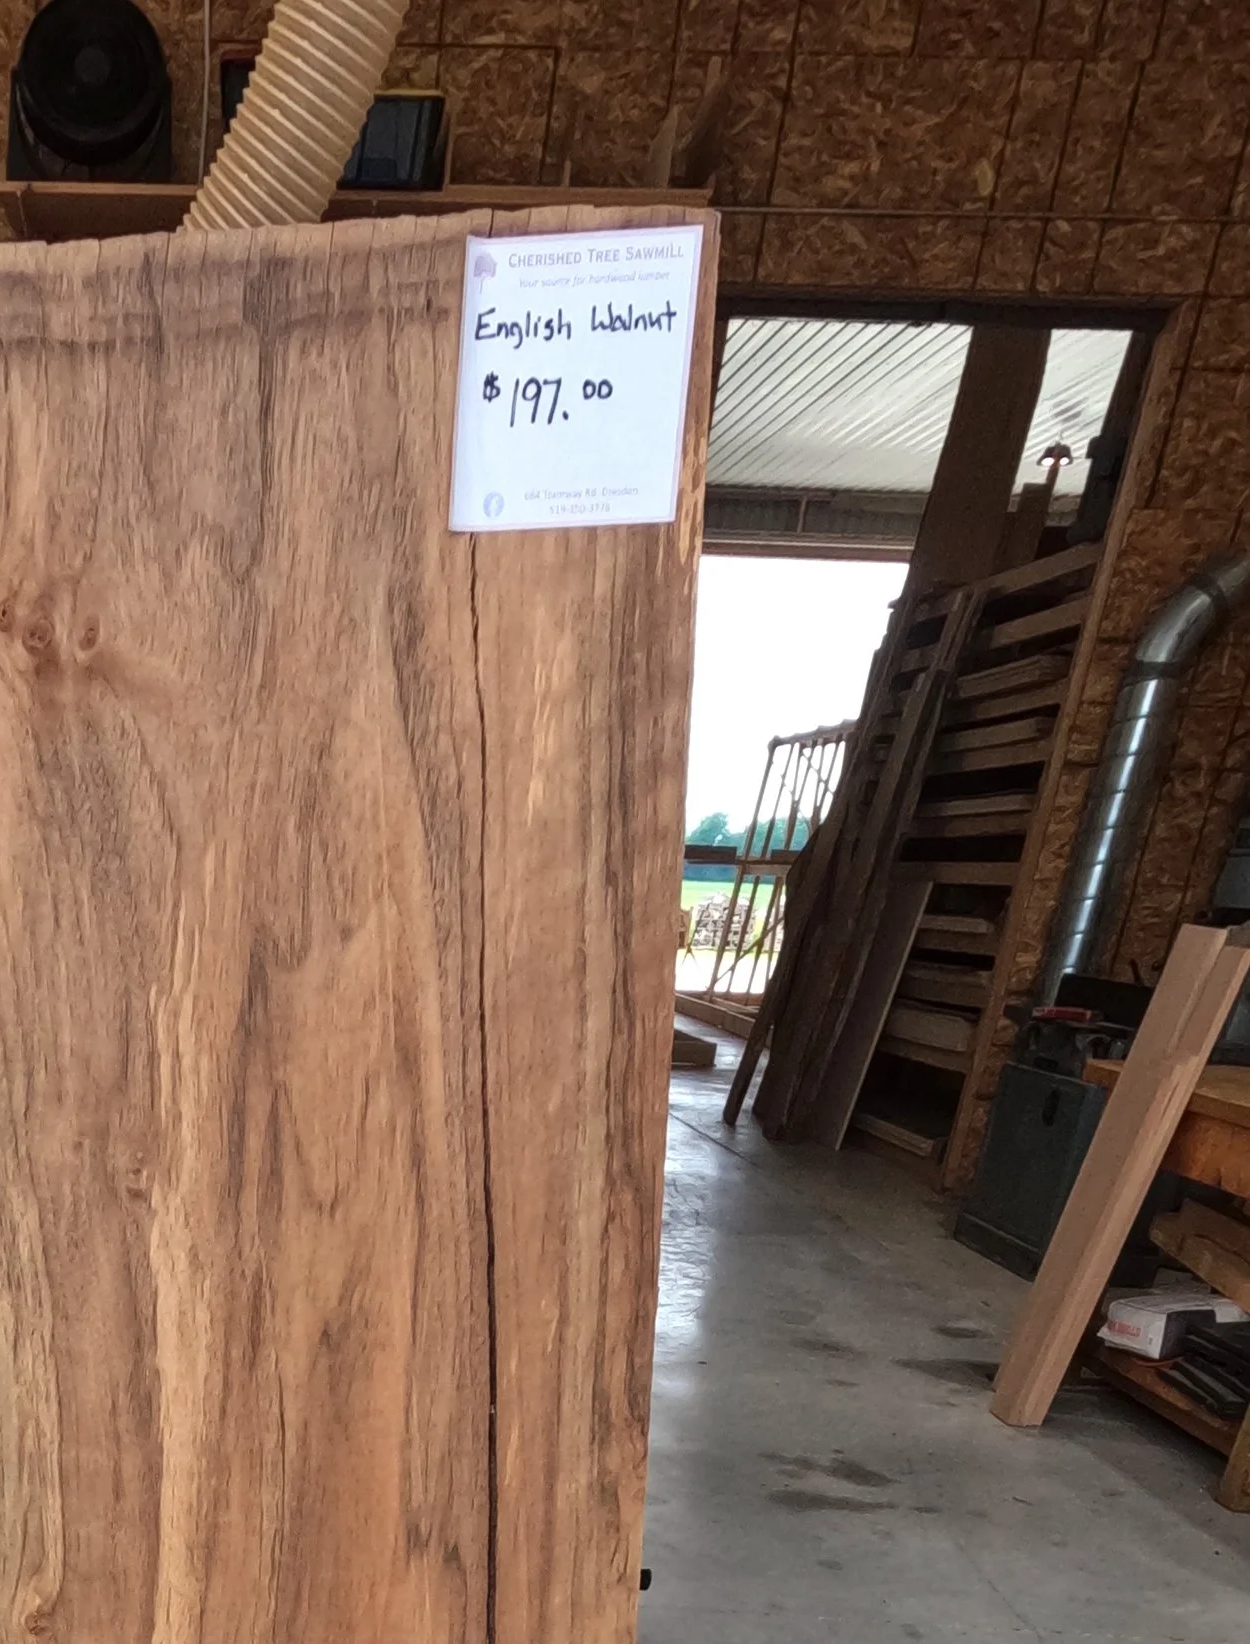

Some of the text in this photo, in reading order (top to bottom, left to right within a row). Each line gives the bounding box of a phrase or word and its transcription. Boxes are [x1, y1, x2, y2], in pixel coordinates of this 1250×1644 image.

[508, 242, 684, 268] CHERISHED TREE SAWMILL
[474, 300, 677, 350] English Walnut
